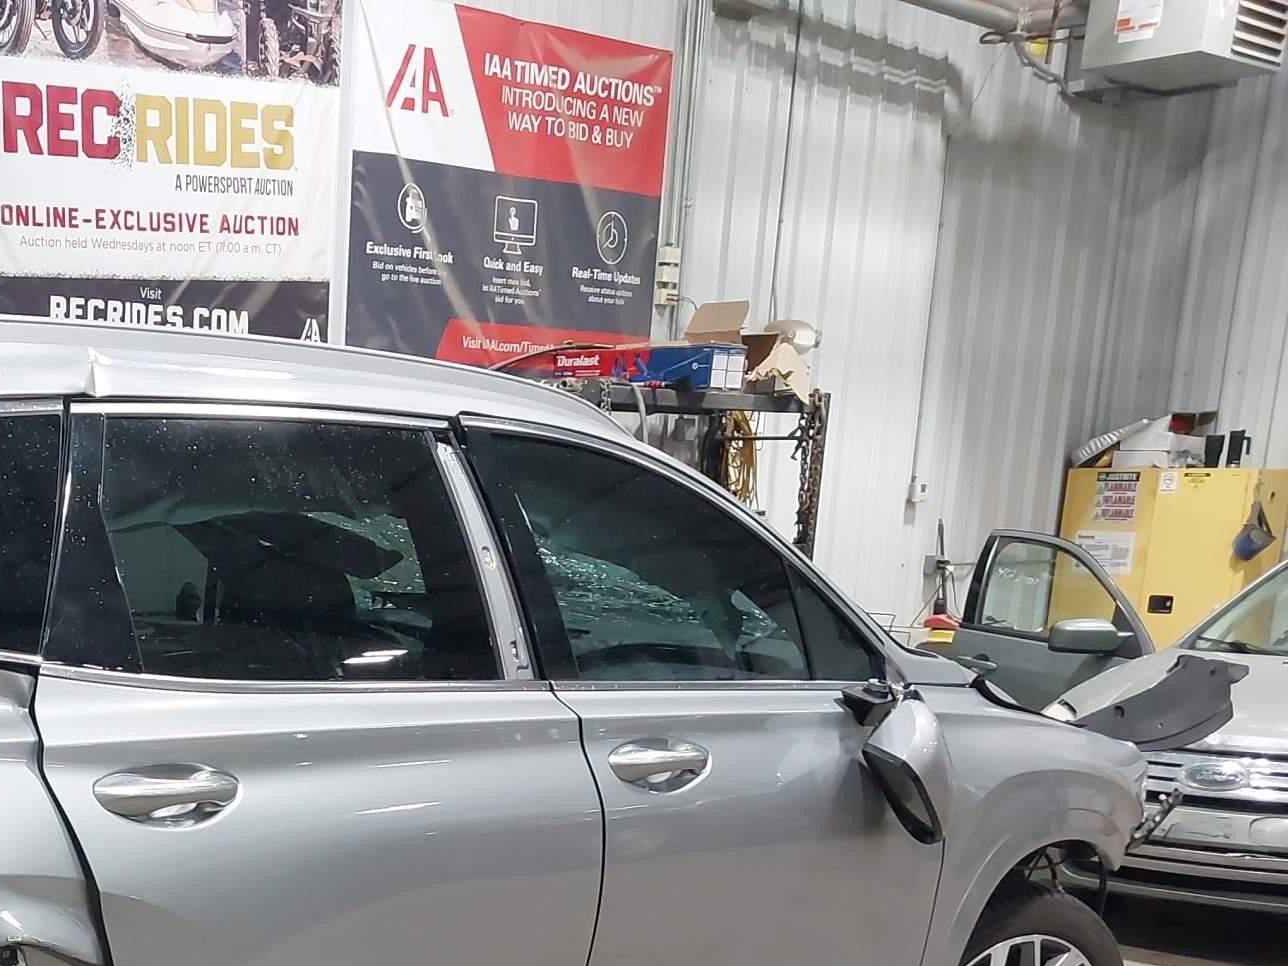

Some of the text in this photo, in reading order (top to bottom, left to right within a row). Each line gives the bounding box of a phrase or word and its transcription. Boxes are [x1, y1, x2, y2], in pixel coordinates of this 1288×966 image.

[484, 53, 511, 80] IAA
[514, 61, 569, 90] TIMED
[502, 86, 644, 128] INTRODUCING A NEW
[508, 111, 633, 149] WAY TO BID & BUY
[175, 174, 293, 196] A POWERSPORT AUCTION
[0, 204, 299, 236] ONLINE-EXCLUSIVE AUCTION
[19, 235, 62, 248] Auction
[65, 237, 87, 249] held
[91, 238, 153, 253] Wednesdays
[156, 241, 167, 251] at
[169, 243, 195, 252] noon
[199, 242, 212, 252] ET
[366, 241, 411, 258] Exclusive
[435, 251, 454, 264] ook
[372, 261, 384, 270] Bid
[395, 264, 417, 273] vehicles
[418, 266, 437, 275] before
[483, 256, 544, 276] Quick and Easy
[572, 267, 641, 285] Real-Time Updates
[381, 273, 390, 281] go
[391, 273, 398, 281] to
[399, 274, 409, 282] the
[420, 277, 441, 286] auction
[140, 286, 162, 300] Visit
[49, 295, 249, 335] RECRIDES.COM
[463, 336, 481, 349] Visit
[556, 354, 600, 367] Duralast
